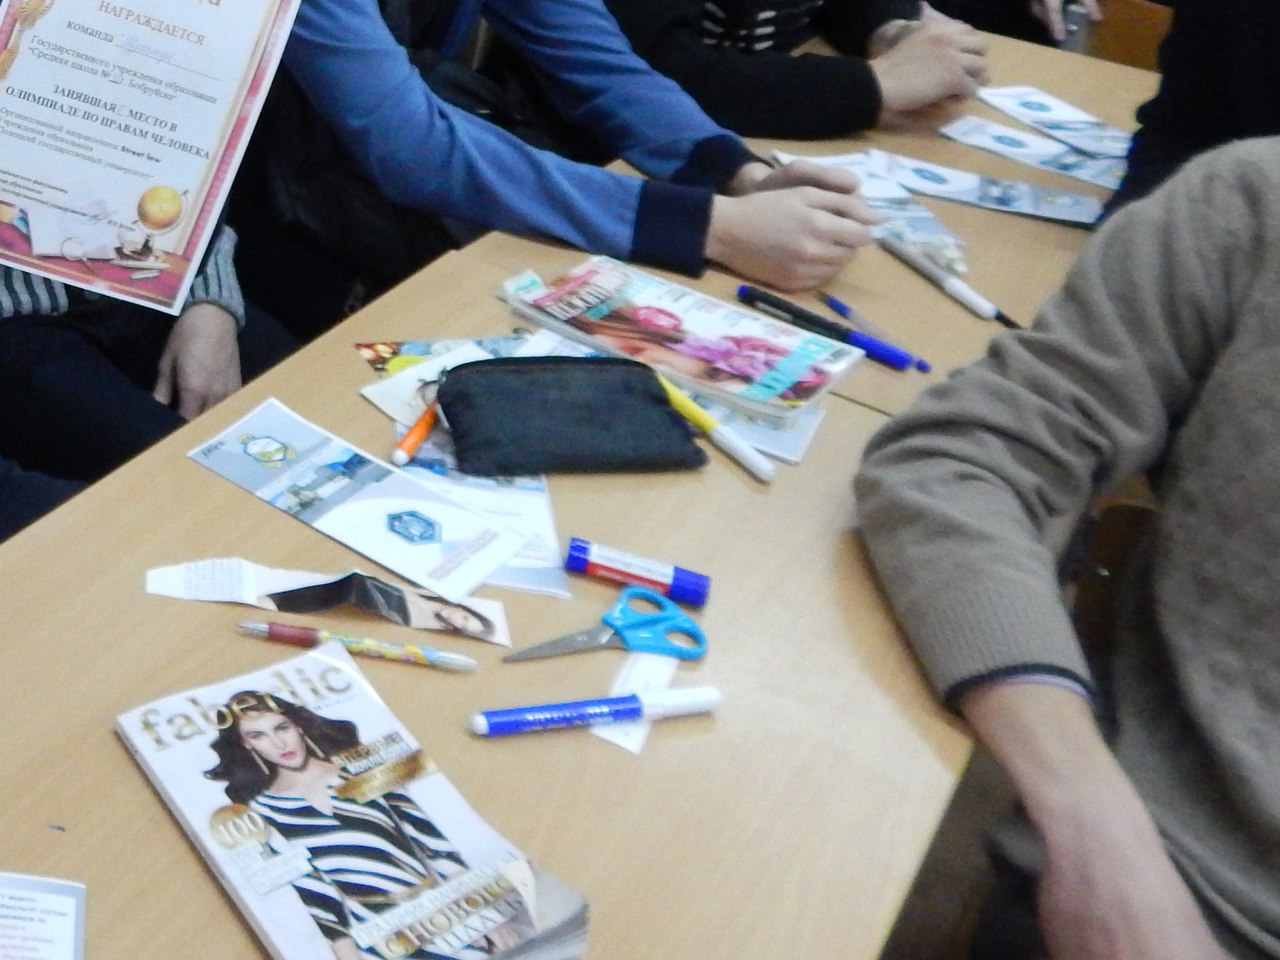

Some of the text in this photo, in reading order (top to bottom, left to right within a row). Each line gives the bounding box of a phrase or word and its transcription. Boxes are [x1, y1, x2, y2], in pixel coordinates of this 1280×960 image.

[66, 20, 115, 43] команда
[98, 0, 206, 46] НАГРАЖДАЕТСЯ
[31, 35, 110, 68] Государственного
[5, 86, 80, 118] ОЛИМПИАДЕ
[81, 110, 100, 123] ПО
[100, 114, 149, 140] ПРАВАМ
[150, 131, 210, 160] ЧЕЛОВЕКА
[53, 85, 116, 113] ЗАНЯВШАЯ
[128, 108, 168, 129] МЕСТО
[169, 122, 179, 133] В
[140, 665, 352, 751] faberlic
[218, 811, 265, 846] 100
